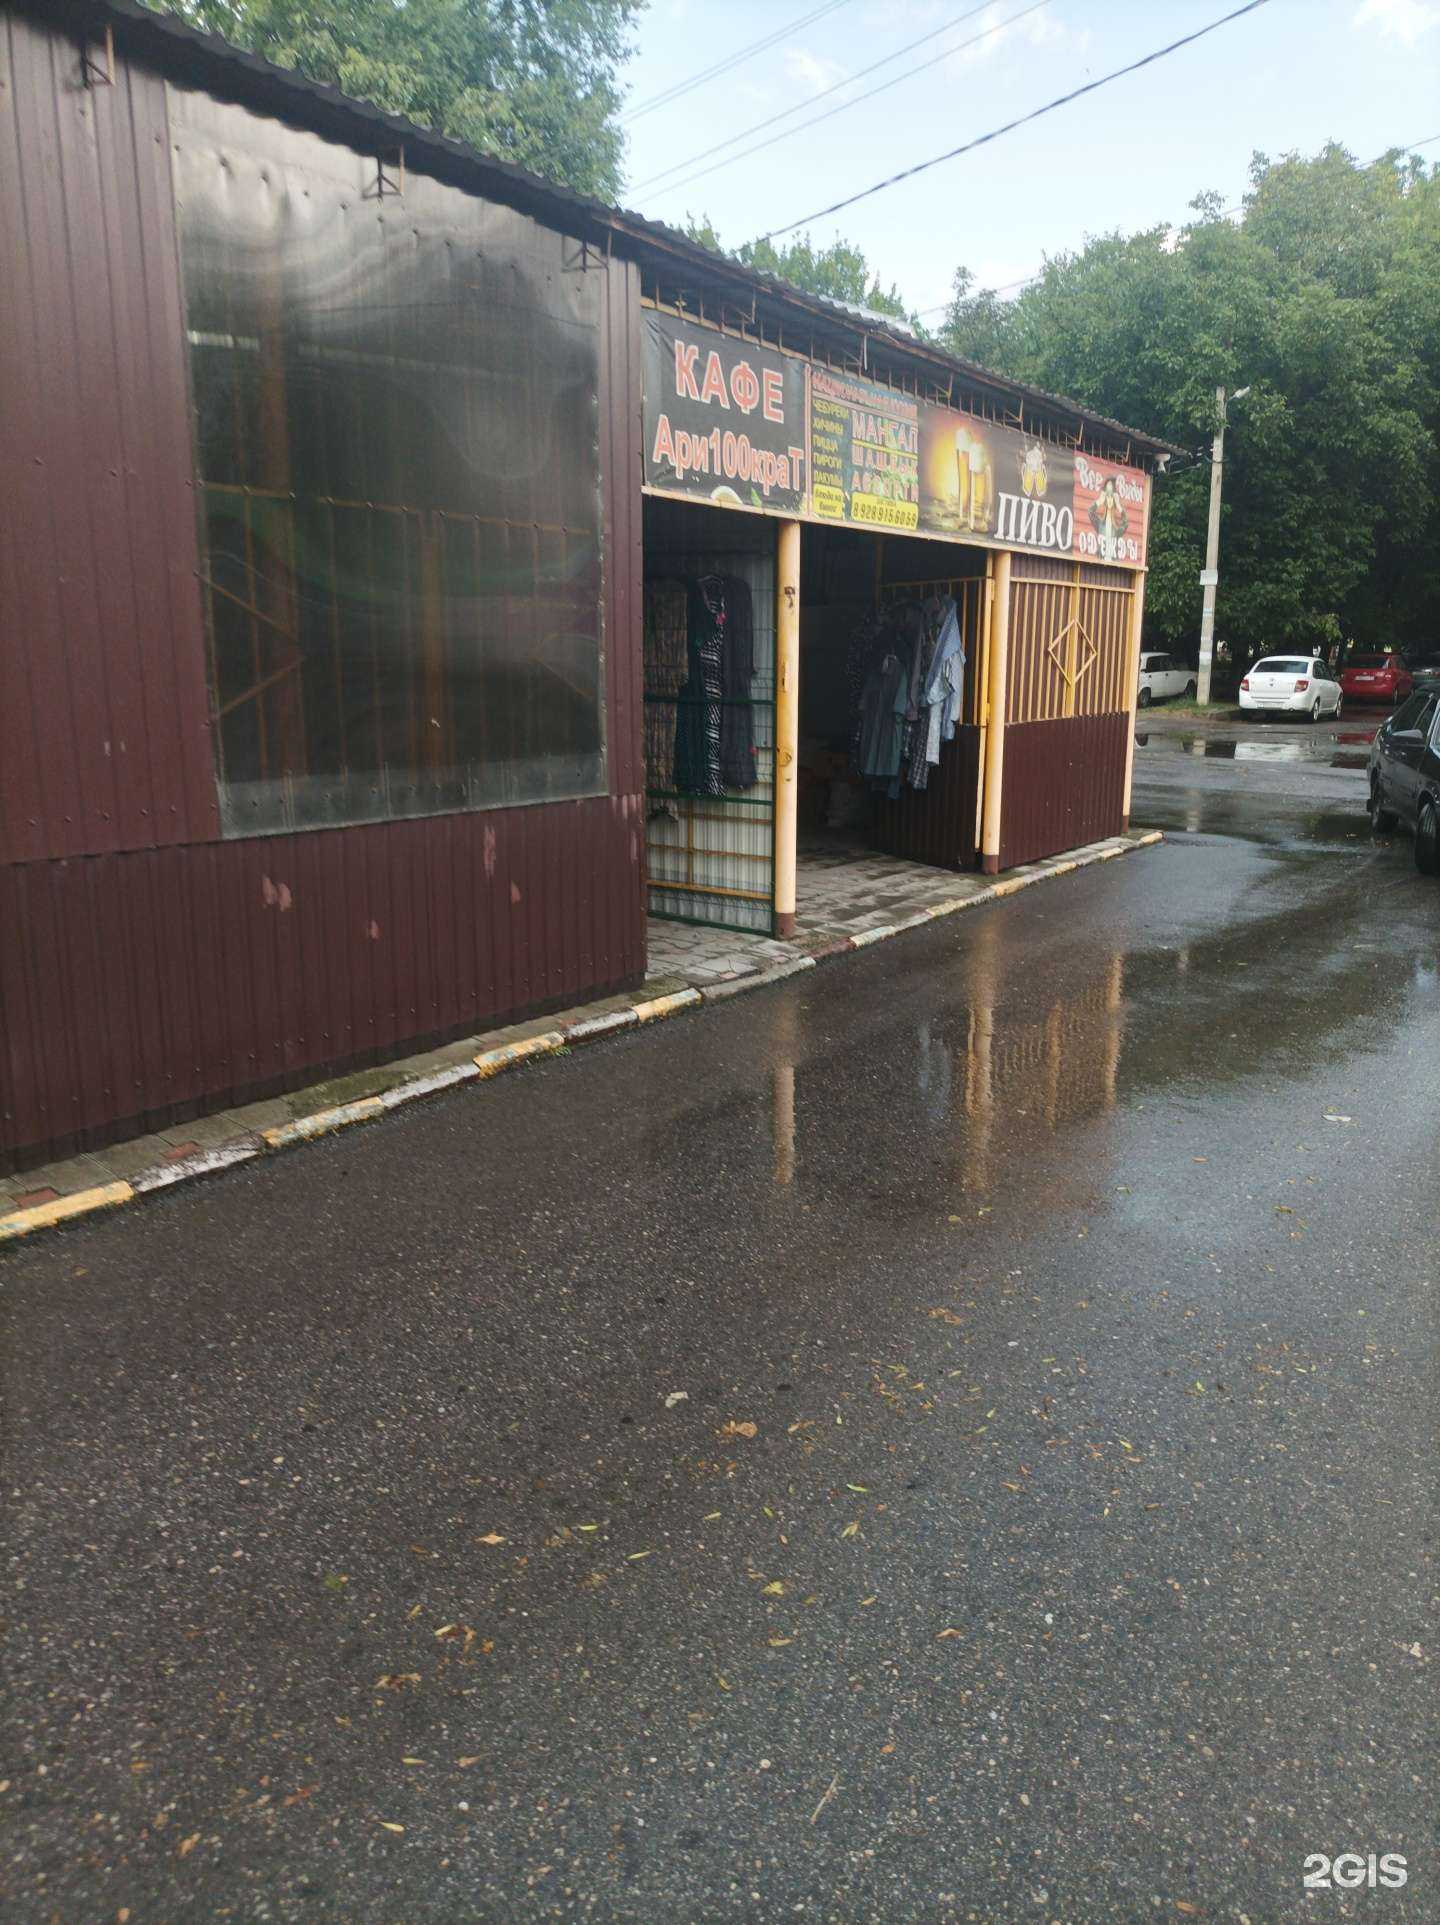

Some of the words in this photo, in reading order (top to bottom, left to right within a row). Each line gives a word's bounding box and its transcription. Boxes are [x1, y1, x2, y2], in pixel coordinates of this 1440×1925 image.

[674, 339, 784, 424] КАФЕ
[851, 410, 918, 454] МАНГАЛ
[652, 414, 804, 496] Ари100краТ
[813, 452, 842, 470] ПИРОГИ
[1075, 457, 1102, 491] Все
[851, 469, 919, 502] АССОРТИ
[994, 492, 1074, 551] ПИВО
